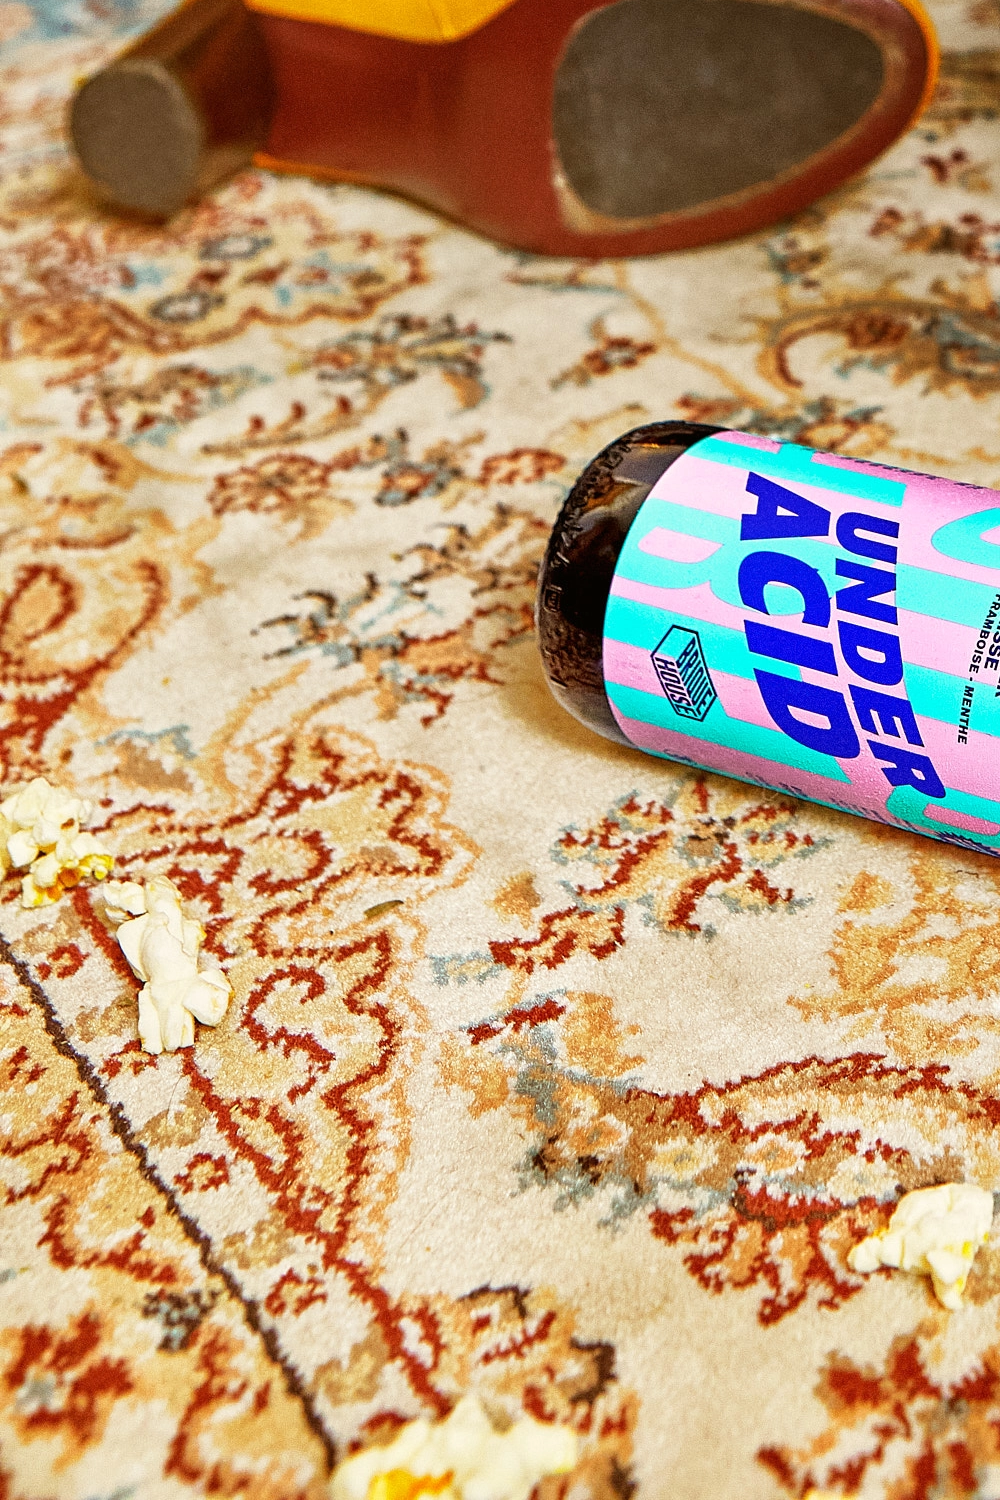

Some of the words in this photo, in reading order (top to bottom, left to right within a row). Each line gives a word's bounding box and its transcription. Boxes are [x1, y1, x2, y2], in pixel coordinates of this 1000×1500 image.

[738, 471, 861, 759] ACID
[654, 656, 698, 717] HOUSE
[676, 636, 713, 715] BRIQUE
[835, 511, 946, 799] UNDER
[958, 685, 975, 744] MENTHE
